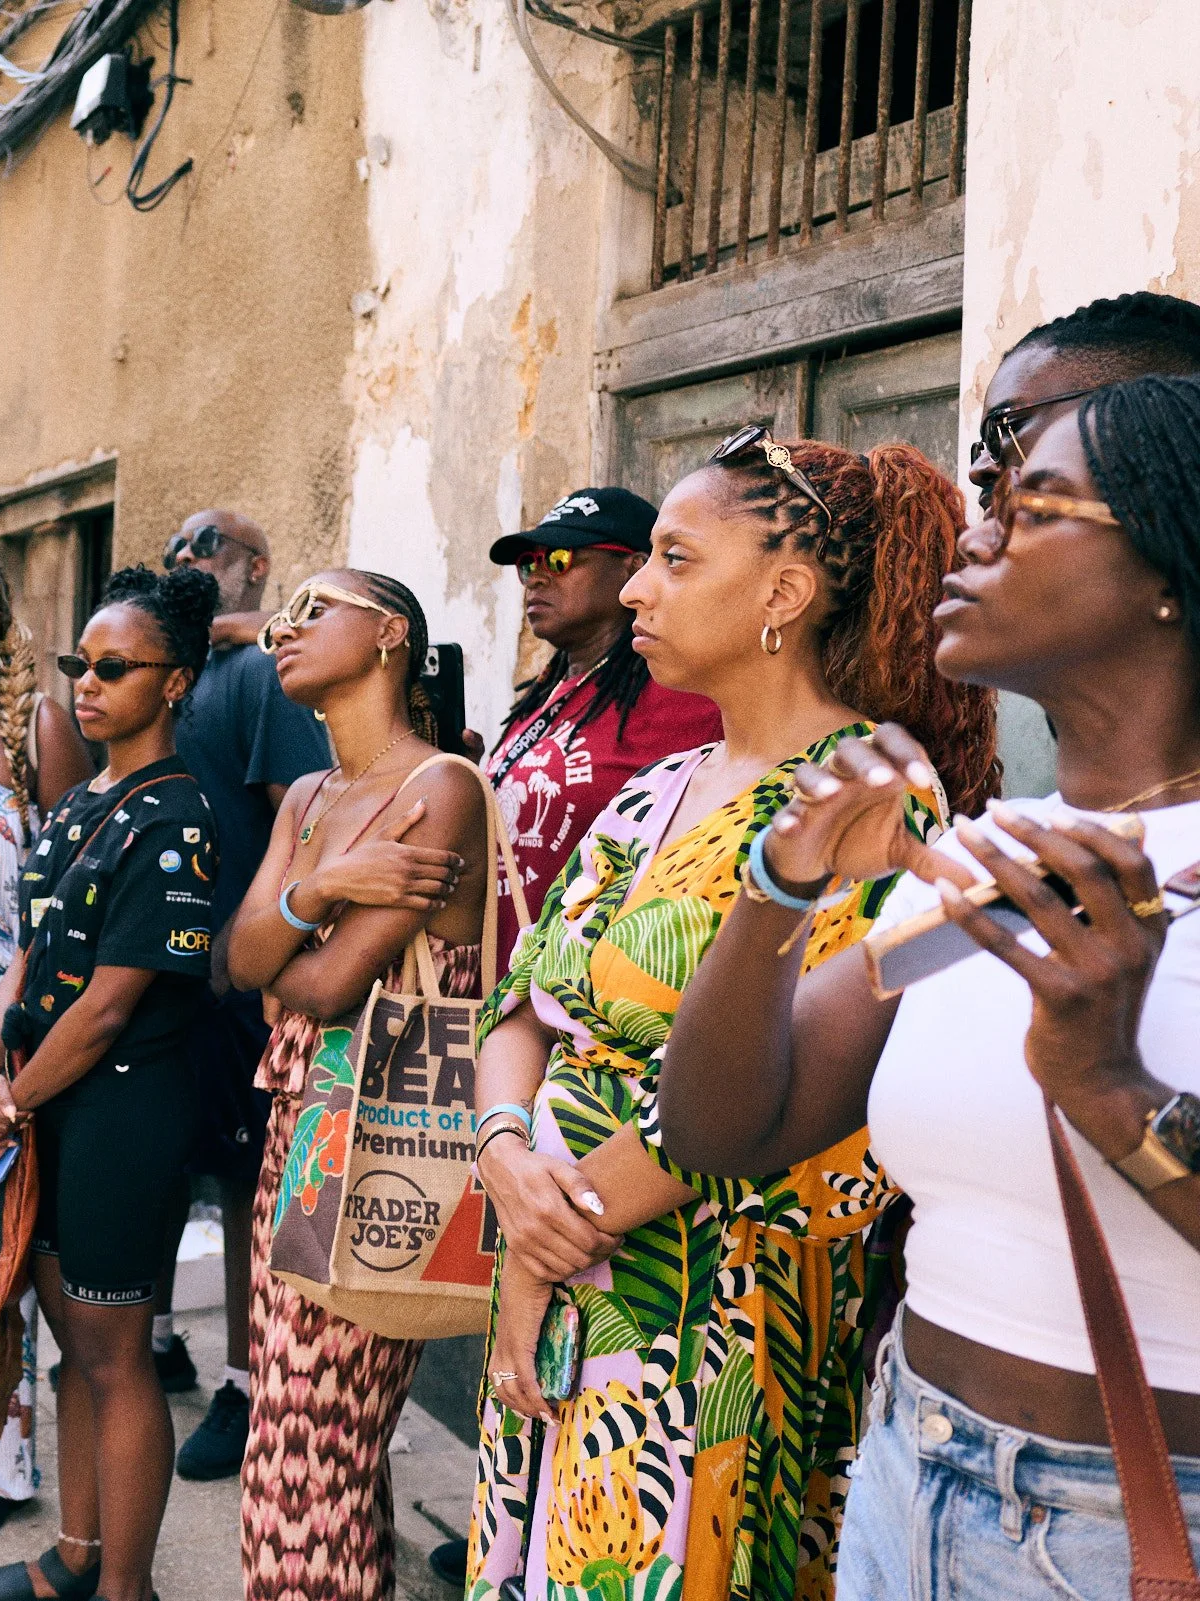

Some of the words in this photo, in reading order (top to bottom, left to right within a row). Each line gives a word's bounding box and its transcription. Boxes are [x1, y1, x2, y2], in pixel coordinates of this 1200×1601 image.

[508, 719, 546, 760] adidas
[356, 1099, 431, 1129] Product
[438, 1109, 464, 1132] of
[352, 1122, 477, 1163] Premium
[344, 1194, 441, 1226] TRADER
[77, 1285, 142, 1301] RELIGION
